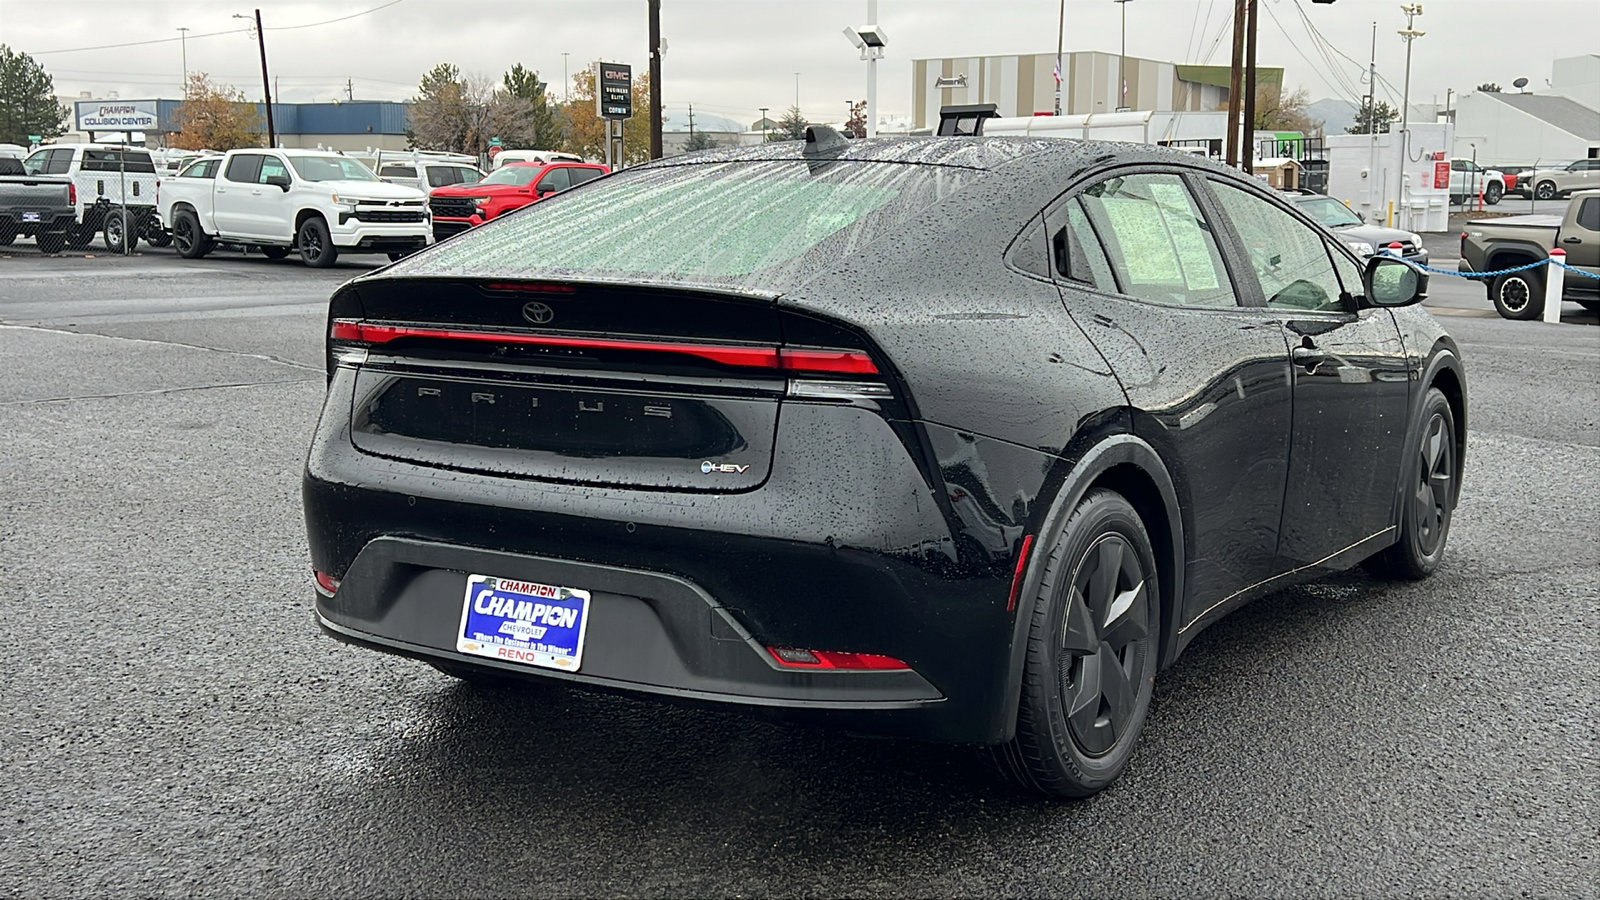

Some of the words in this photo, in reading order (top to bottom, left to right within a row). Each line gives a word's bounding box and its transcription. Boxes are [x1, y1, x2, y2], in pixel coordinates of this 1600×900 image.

[605, 70, 629, 80] GMC
[99, 105, 136, 117] CHAMPION
[84, 117, 121, 126] COLLISION
[122, 117, 152, 125] CENTER
[418, 387, 672, 418] PRIUS
[500, 580, 557, 598] CHAMPION
[474, 589, 579, 629] CHAMPION
[502, 623, 543, 636] CHEVROLET
[498, 648, 535, 662] RENO
